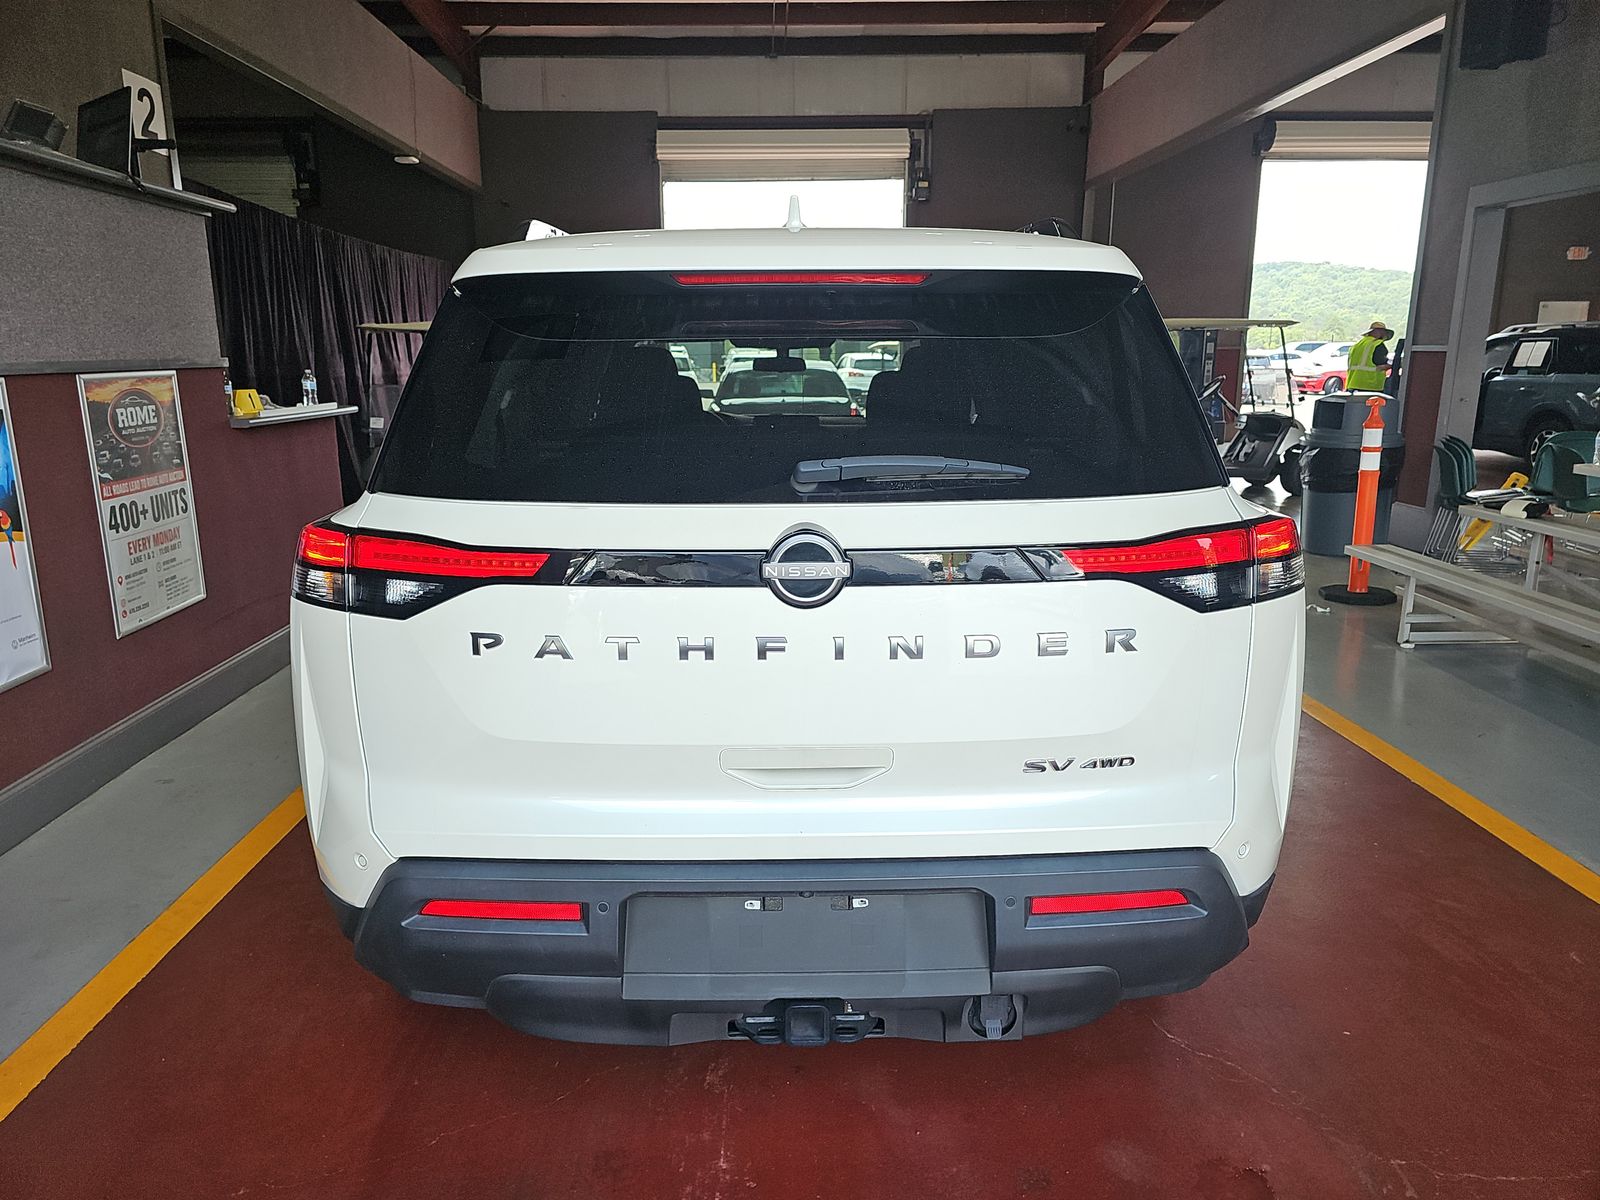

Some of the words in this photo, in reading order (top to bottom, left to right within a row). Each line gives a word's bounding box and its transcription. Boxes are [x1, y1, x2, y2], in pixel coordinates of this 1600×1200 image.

[138, 87, 159, 139] 2
[116, 405, 158, 428] ROME
[102, 485, 113, 498] ALL
[109, 500, 149, 534] 400+
[150, 487, 188, 523] UNITS
[127, 535, 151, 556] EVERY
[152, 525, 181, 547] MONDAY
[130, 554, 143, 566] LANE
[765, 565, 848, 577] NISSAN
[470, 628, 1138, 661] PATHFINDER
[1023, 757, 1076, 773] SV
[1080, 757, 1135, 769] 4WD
